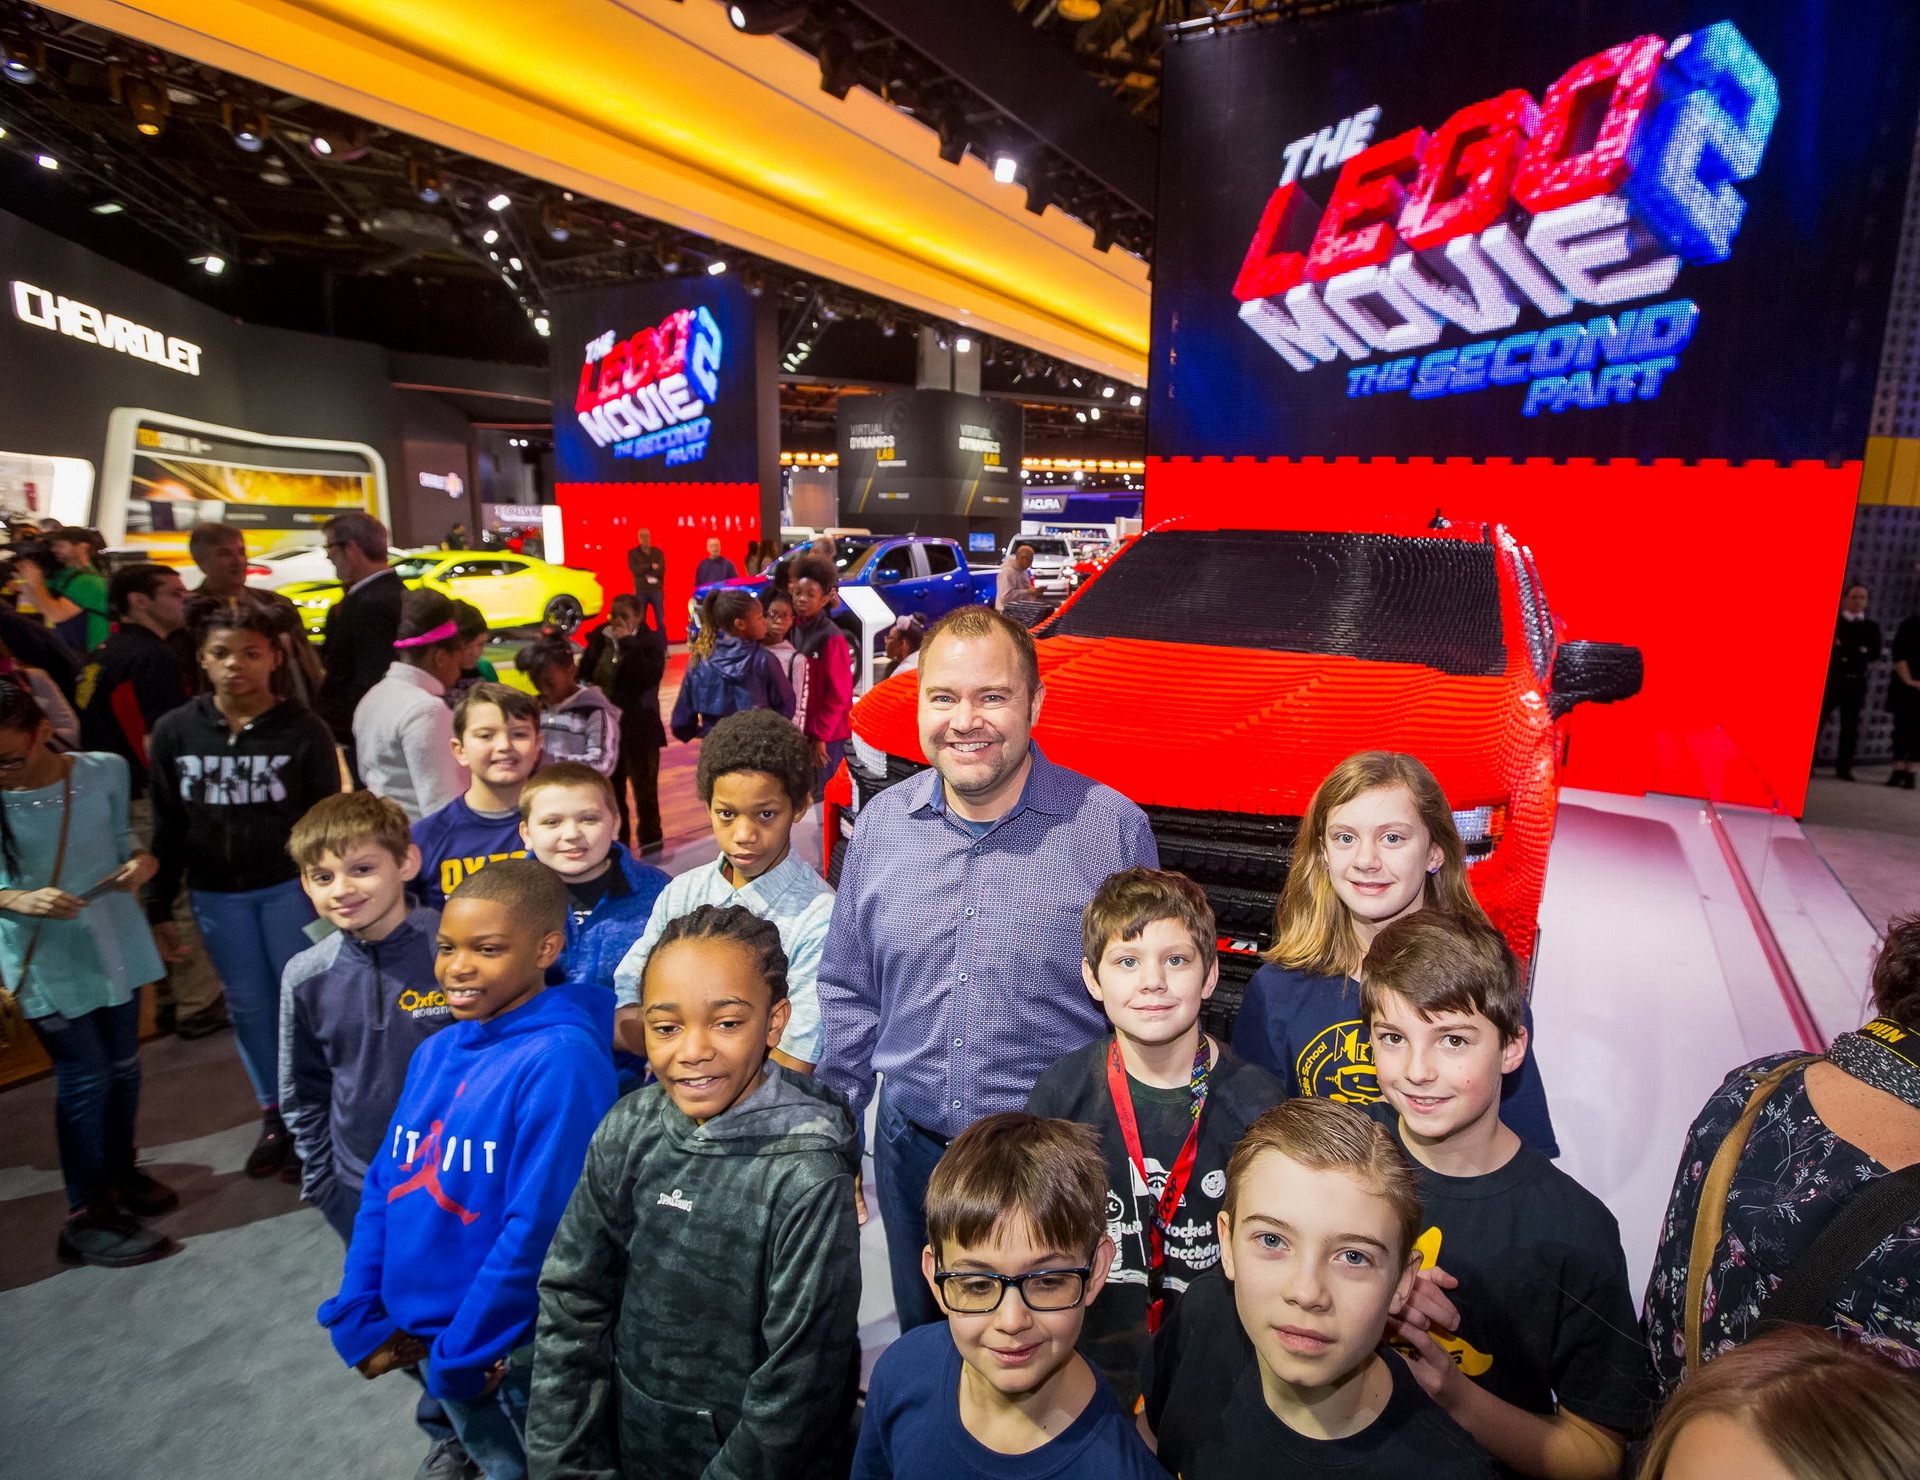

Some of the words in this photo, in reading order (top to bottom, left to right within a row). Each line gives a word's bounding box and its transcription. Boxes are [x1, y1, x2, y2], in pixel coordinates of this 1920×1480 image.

[1281, 104, 1382, 186] THE
[1640, 19, 1779, 266] 2
[1232, 34, 1666, 300] LEGO
[1238, 193, 1682, 371] MOVIE
[9, 280, 201, 376] CHEVROLET
[585, 329, 616, 364] THE
[1346, 356, 1417, 399] THE
[1409, 299, 1699, 400] SECOND
[576, 308, 691, 413] LEGO
[687, 305, 722, 405] 2
[1521, 355, 1681, 418] PART
[578, 373, 704, 447] MOVIE
[850, 423, 884, 436] VIRTUAL
[960, 424, 991, 438] VIRTUAL
[633, 417, 712, 460] SECOND
[665, 440, 708, 467] PART
[850, 435, 895, 449] DYNAMICS
[876, 448, 895, 460] LAB
[959, 437, 1000, 453] DYNAMICS
[983, 453, 1000, 465] LAB
[1029, 498, 1061, 510] ACURA
[175, 755, 292, 805] PINK
[399, 989, 449, 1011] Oxfo
[1302, 1041, 1328, 1077] School
